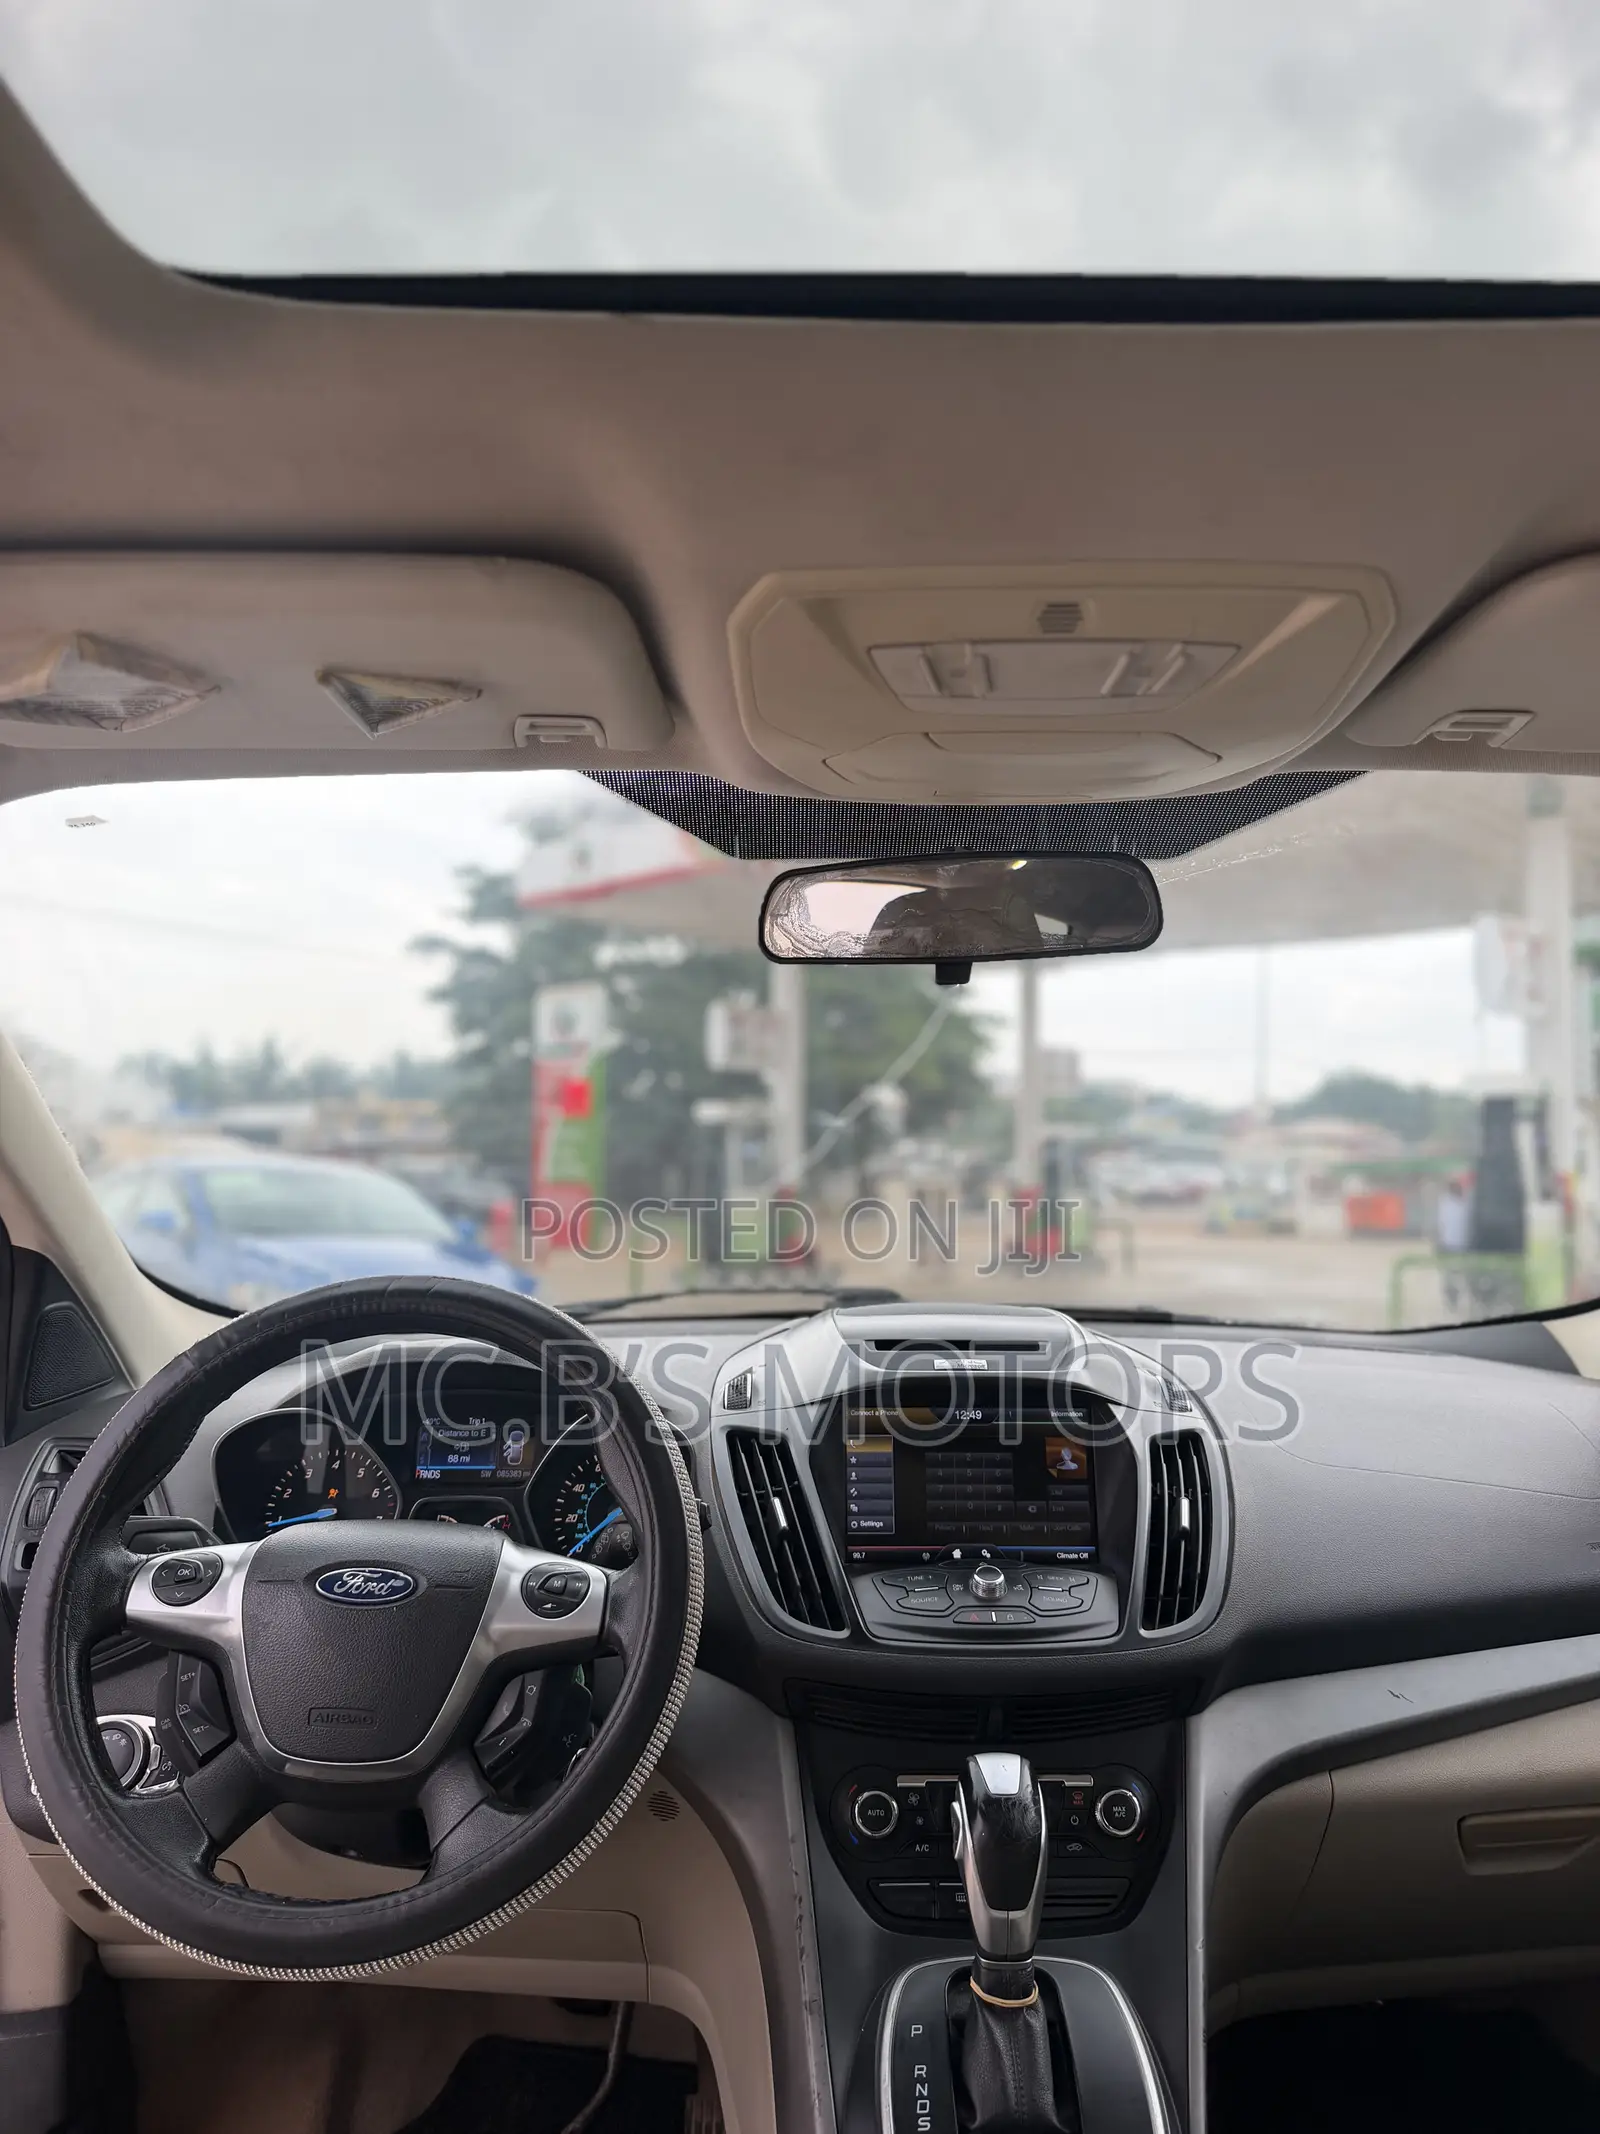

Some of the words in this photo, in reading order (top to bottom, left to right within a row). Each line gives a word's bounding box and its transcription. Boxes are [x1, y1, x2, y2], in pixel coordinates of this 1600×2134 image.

[954, 1410, 982, 1420] 12:49
[469, 1417, 481, 1426] Trip
[438, 1429, 469, 1437] Distance
[481, 1429, 486, 1437] E
[447, 1454, 459, 1463] 88
[460, 1454, 471, 1462] mi
[331, 1460, 340, 1470] 4
[305, 1469, 313, 1479] 3
[357, 1468, 365, 1477] 5
[480, 1470, 492, 1478] SW
[573, 1483, 585, 1492] 40
[283, 1489, 292, 1499] 2
[372, 1488, 380, 1498] 6
[565, 1514, 578, 1522] 20
[860, 1520, 883, 1529] Settings
[1056, 1551, 1078, 1559] Climate
[1079, 1551, 1089, 1559] Off
[333, 1570, 395, 1595] Ford
[553, 1580, 561, 1588] M
[911, 2024, 923, 2038] P
[914, 2064, 927, 2078] R
[915, 2083, 928, 2097] N
[916, 2100, 930, 2114] D
[917, 2116, 931, 2131] S
